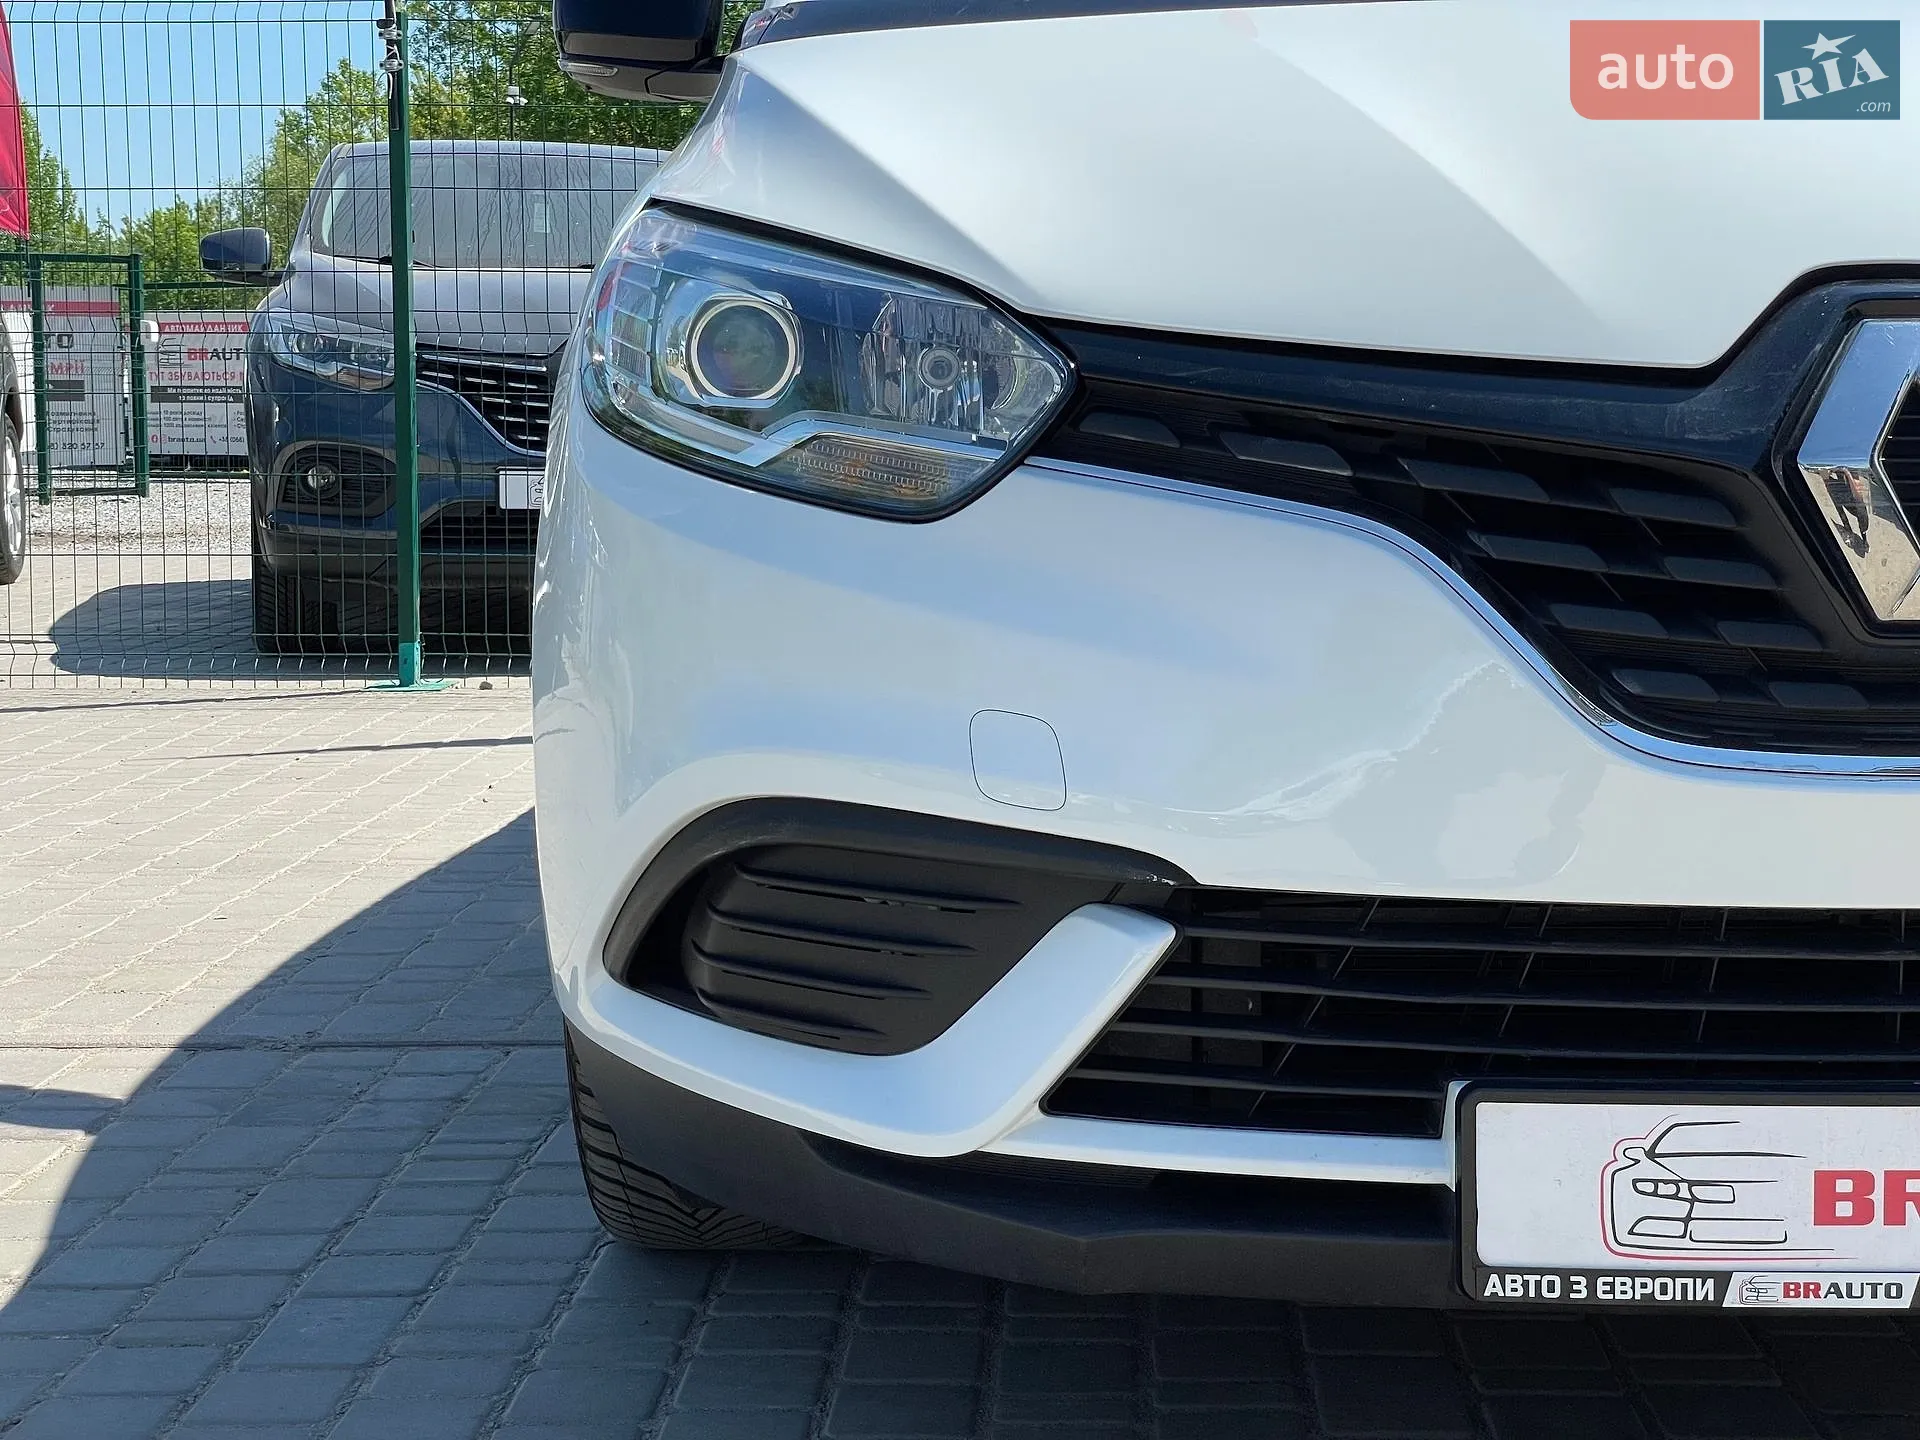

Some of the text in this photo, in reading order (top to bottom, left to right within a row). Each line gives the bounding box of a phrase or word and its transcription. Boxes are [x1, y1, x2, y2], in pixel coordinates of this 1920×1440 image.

[187, 347, 245, 361] BRAUT
[1483, 1274, 1560, 1299] АВТО
[1595, 1276, 1715, 1301] ЄВРОПИ
[1782, 1280, 1904, 1300] BRAUTO
